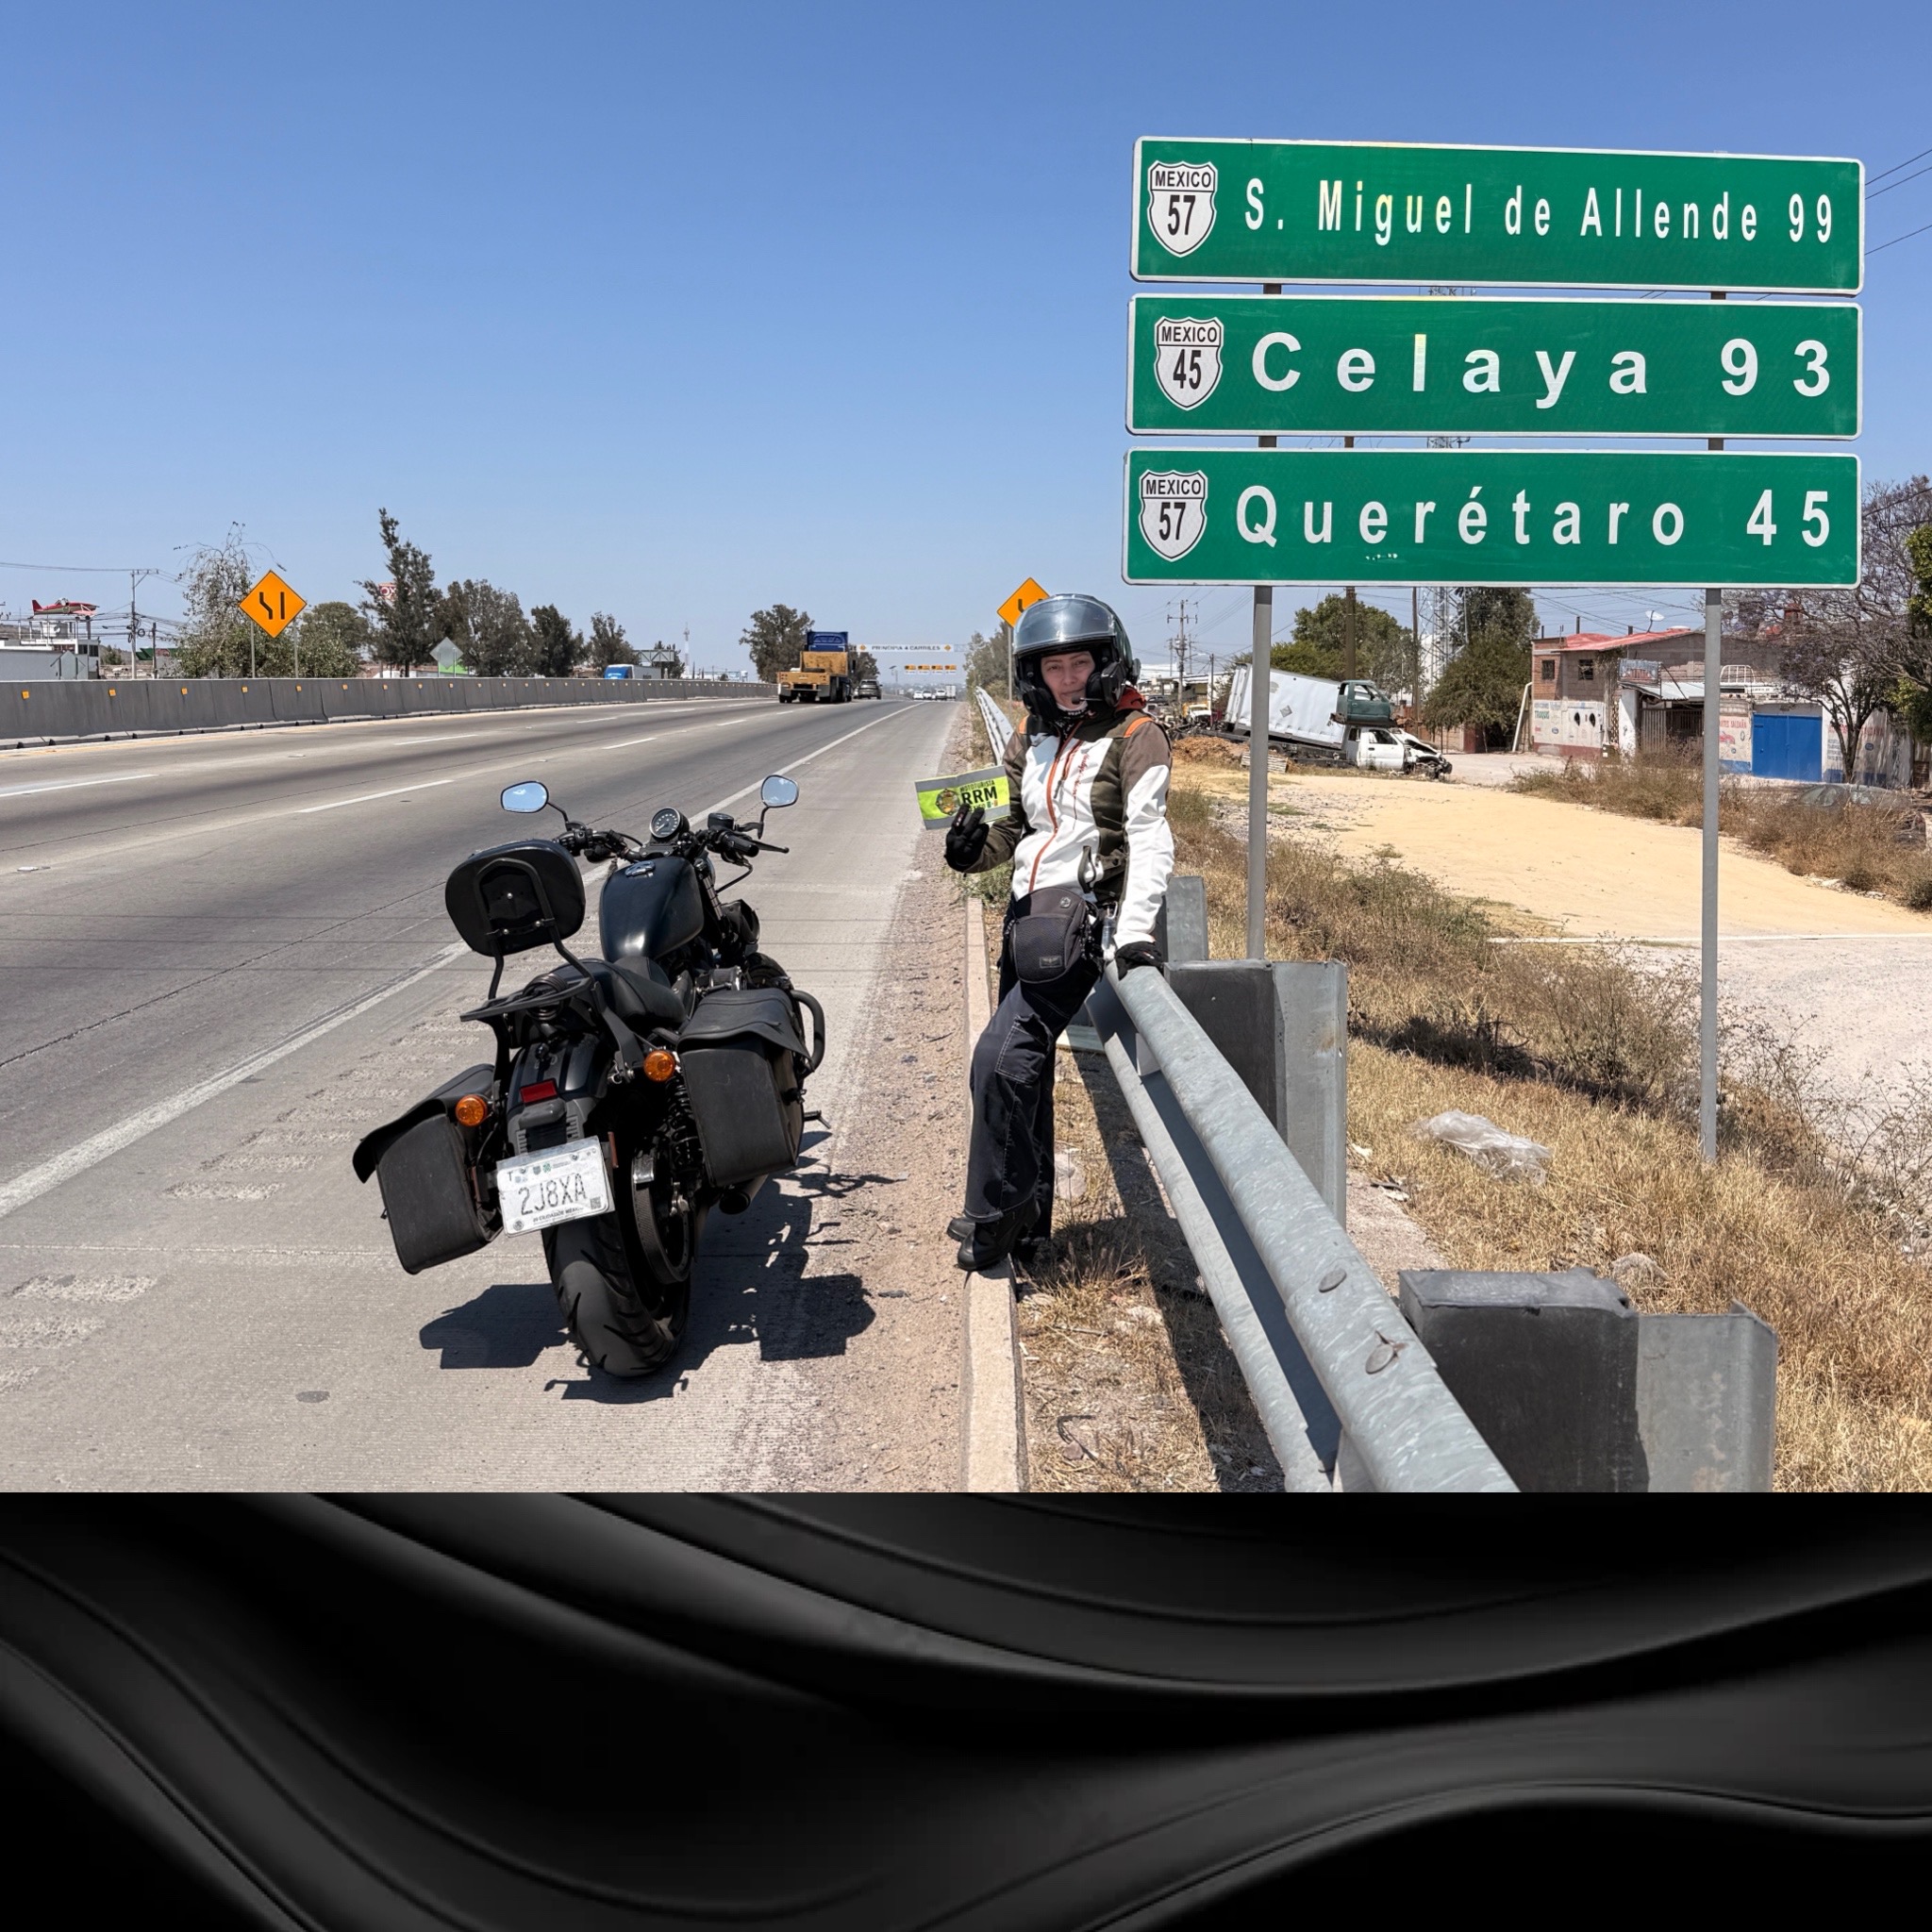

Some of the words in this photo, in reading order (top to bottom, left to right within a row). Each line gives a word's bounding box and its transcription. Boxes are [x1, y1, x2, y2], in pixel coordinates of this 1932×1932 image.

[1155, 170, 1212, 188] MEXICO
[1167, 194, 1196, 236] 57
[1244, 177, 1284, 231] S.
[1318, 179, 1472, 246] Miguel
[1505, 185, 1551, 236] de
[1580, 187, 1757, 242] Allende
[1789, 192, 1832, 243] 99
[1161, 325, 1218, 343] MEXICO
[1173, 348, 1202, 391] 45
[1252, 331, 1647, 409] Celaya
[1721, 338, 1830, 397] 93
[1145, 479, 1202, 495] MEXICO
[1158, 501, 1187, 541] 57
[1236, 485, 1685, 548] Querétaro
[1746, 489, 1830, 547] 45
[960, 780, 995, 792] MOTOTURISTA
[961, 786, 998, 805] RRM
[518, 1173, 587, 1216] 2J8XA
